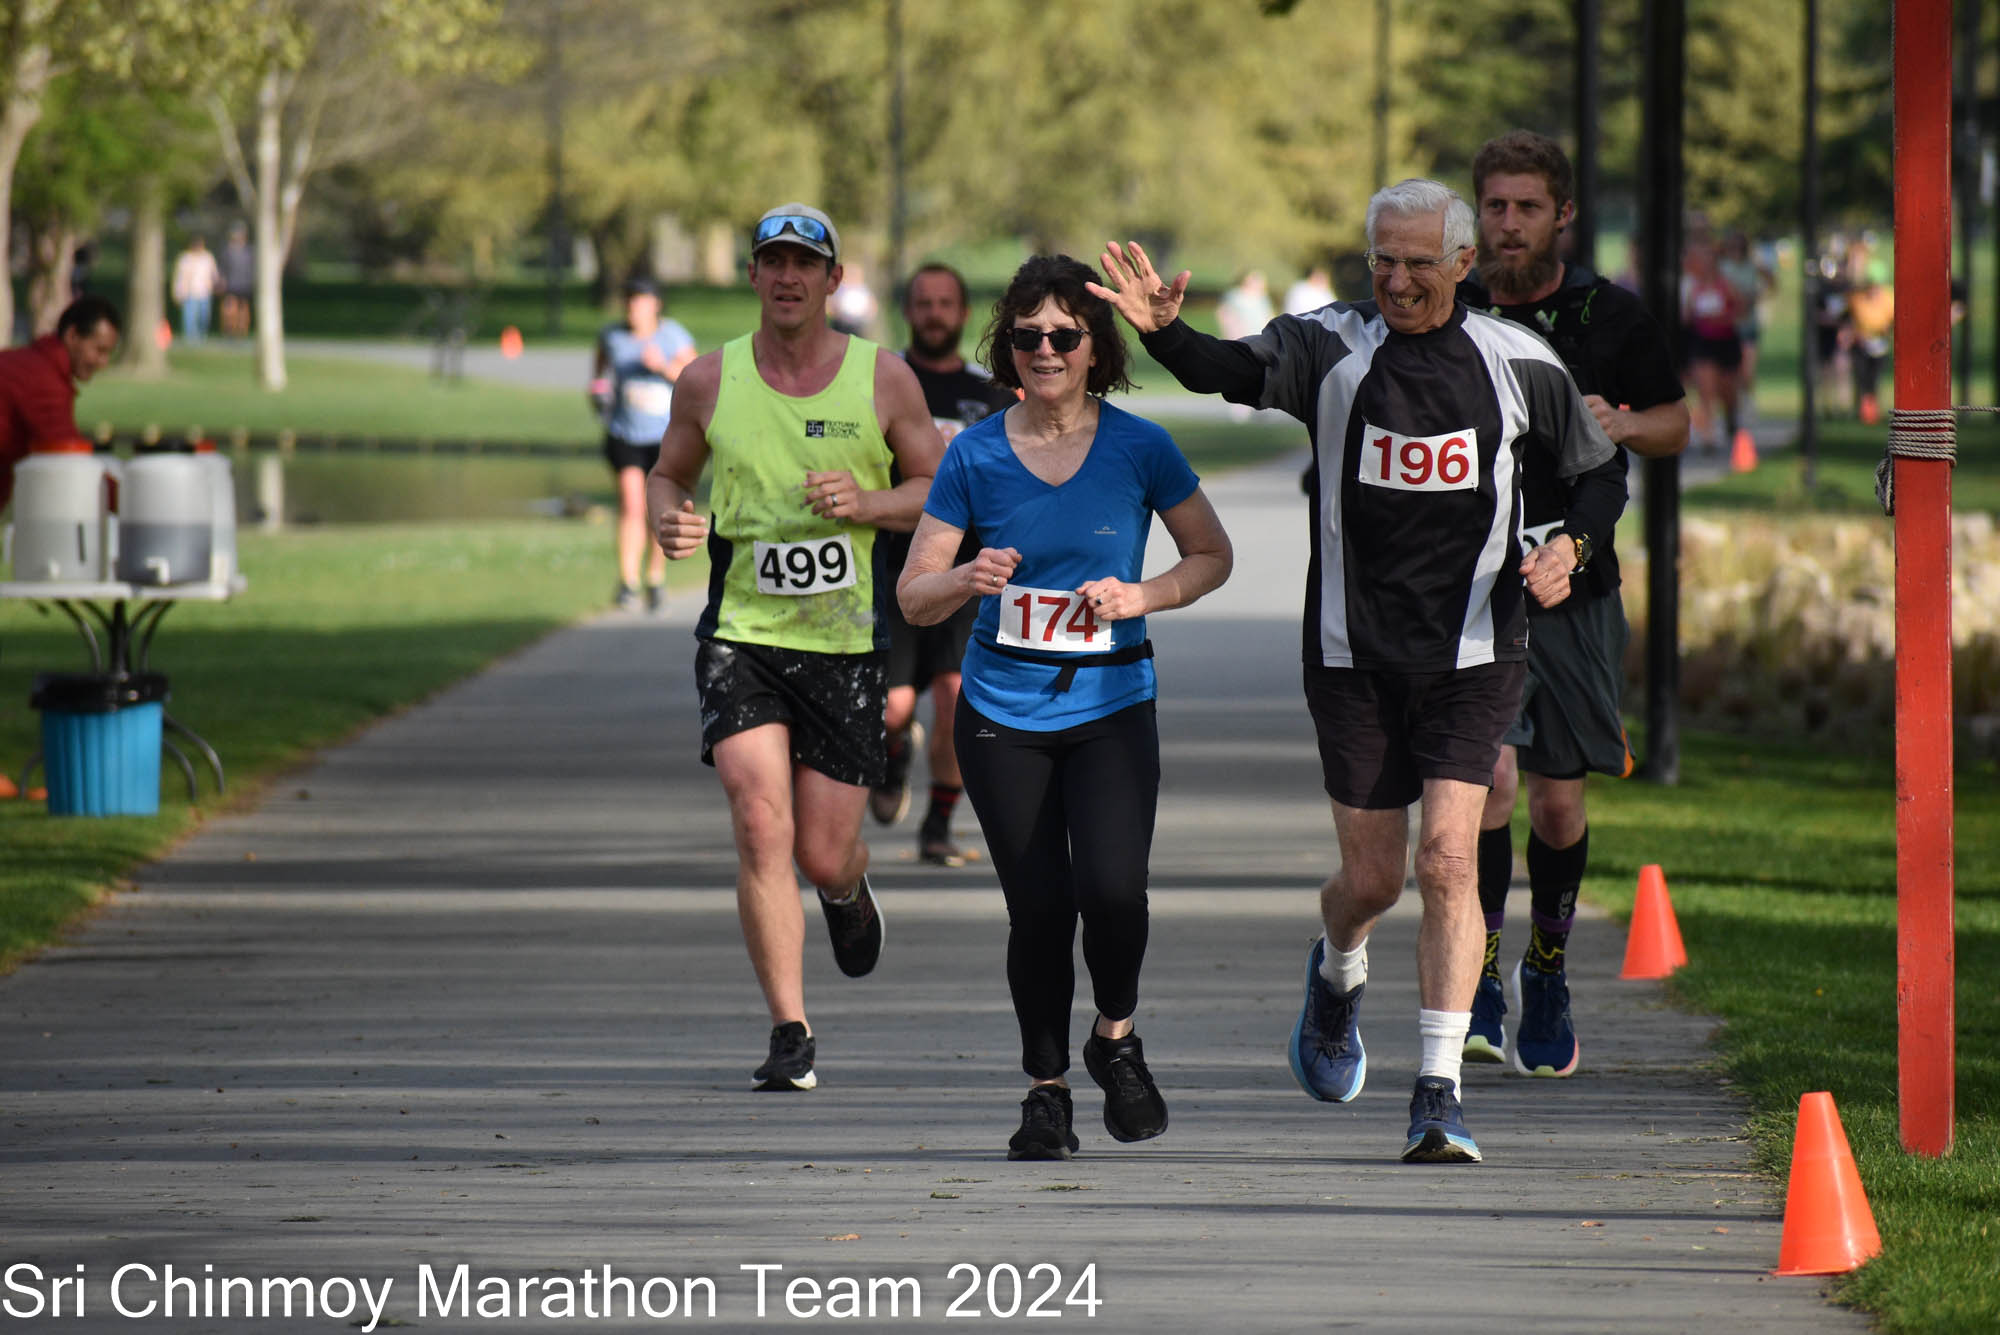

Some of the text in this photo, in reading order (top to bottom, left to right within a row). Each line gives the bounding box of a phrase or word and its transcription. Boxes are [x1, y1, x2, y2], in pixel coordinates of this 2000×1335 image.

[1373, 435, 1470, 485] 196
[760, 541, 848, 589] 499
[1013, 593, 1099, 643] 174
